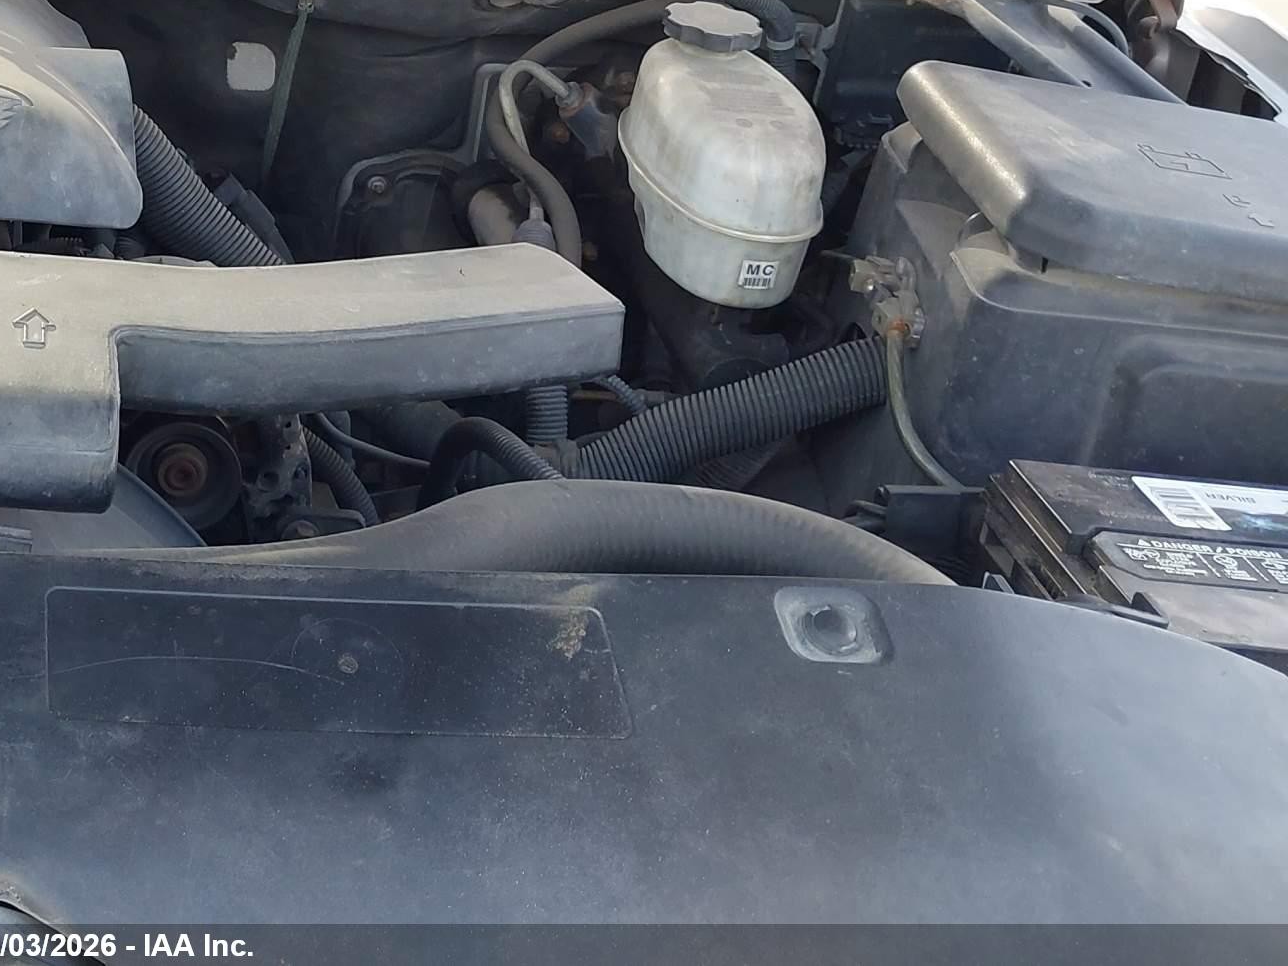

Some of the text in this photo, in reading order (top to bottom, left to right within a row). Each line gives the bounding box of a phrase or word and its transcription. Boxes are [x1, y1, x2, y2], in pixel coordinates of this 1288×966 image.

[747, 264, 775, 276] MC
[1151, 540, 1213, 552] DANGER
[1225, 547, 1283, 559] POISON
